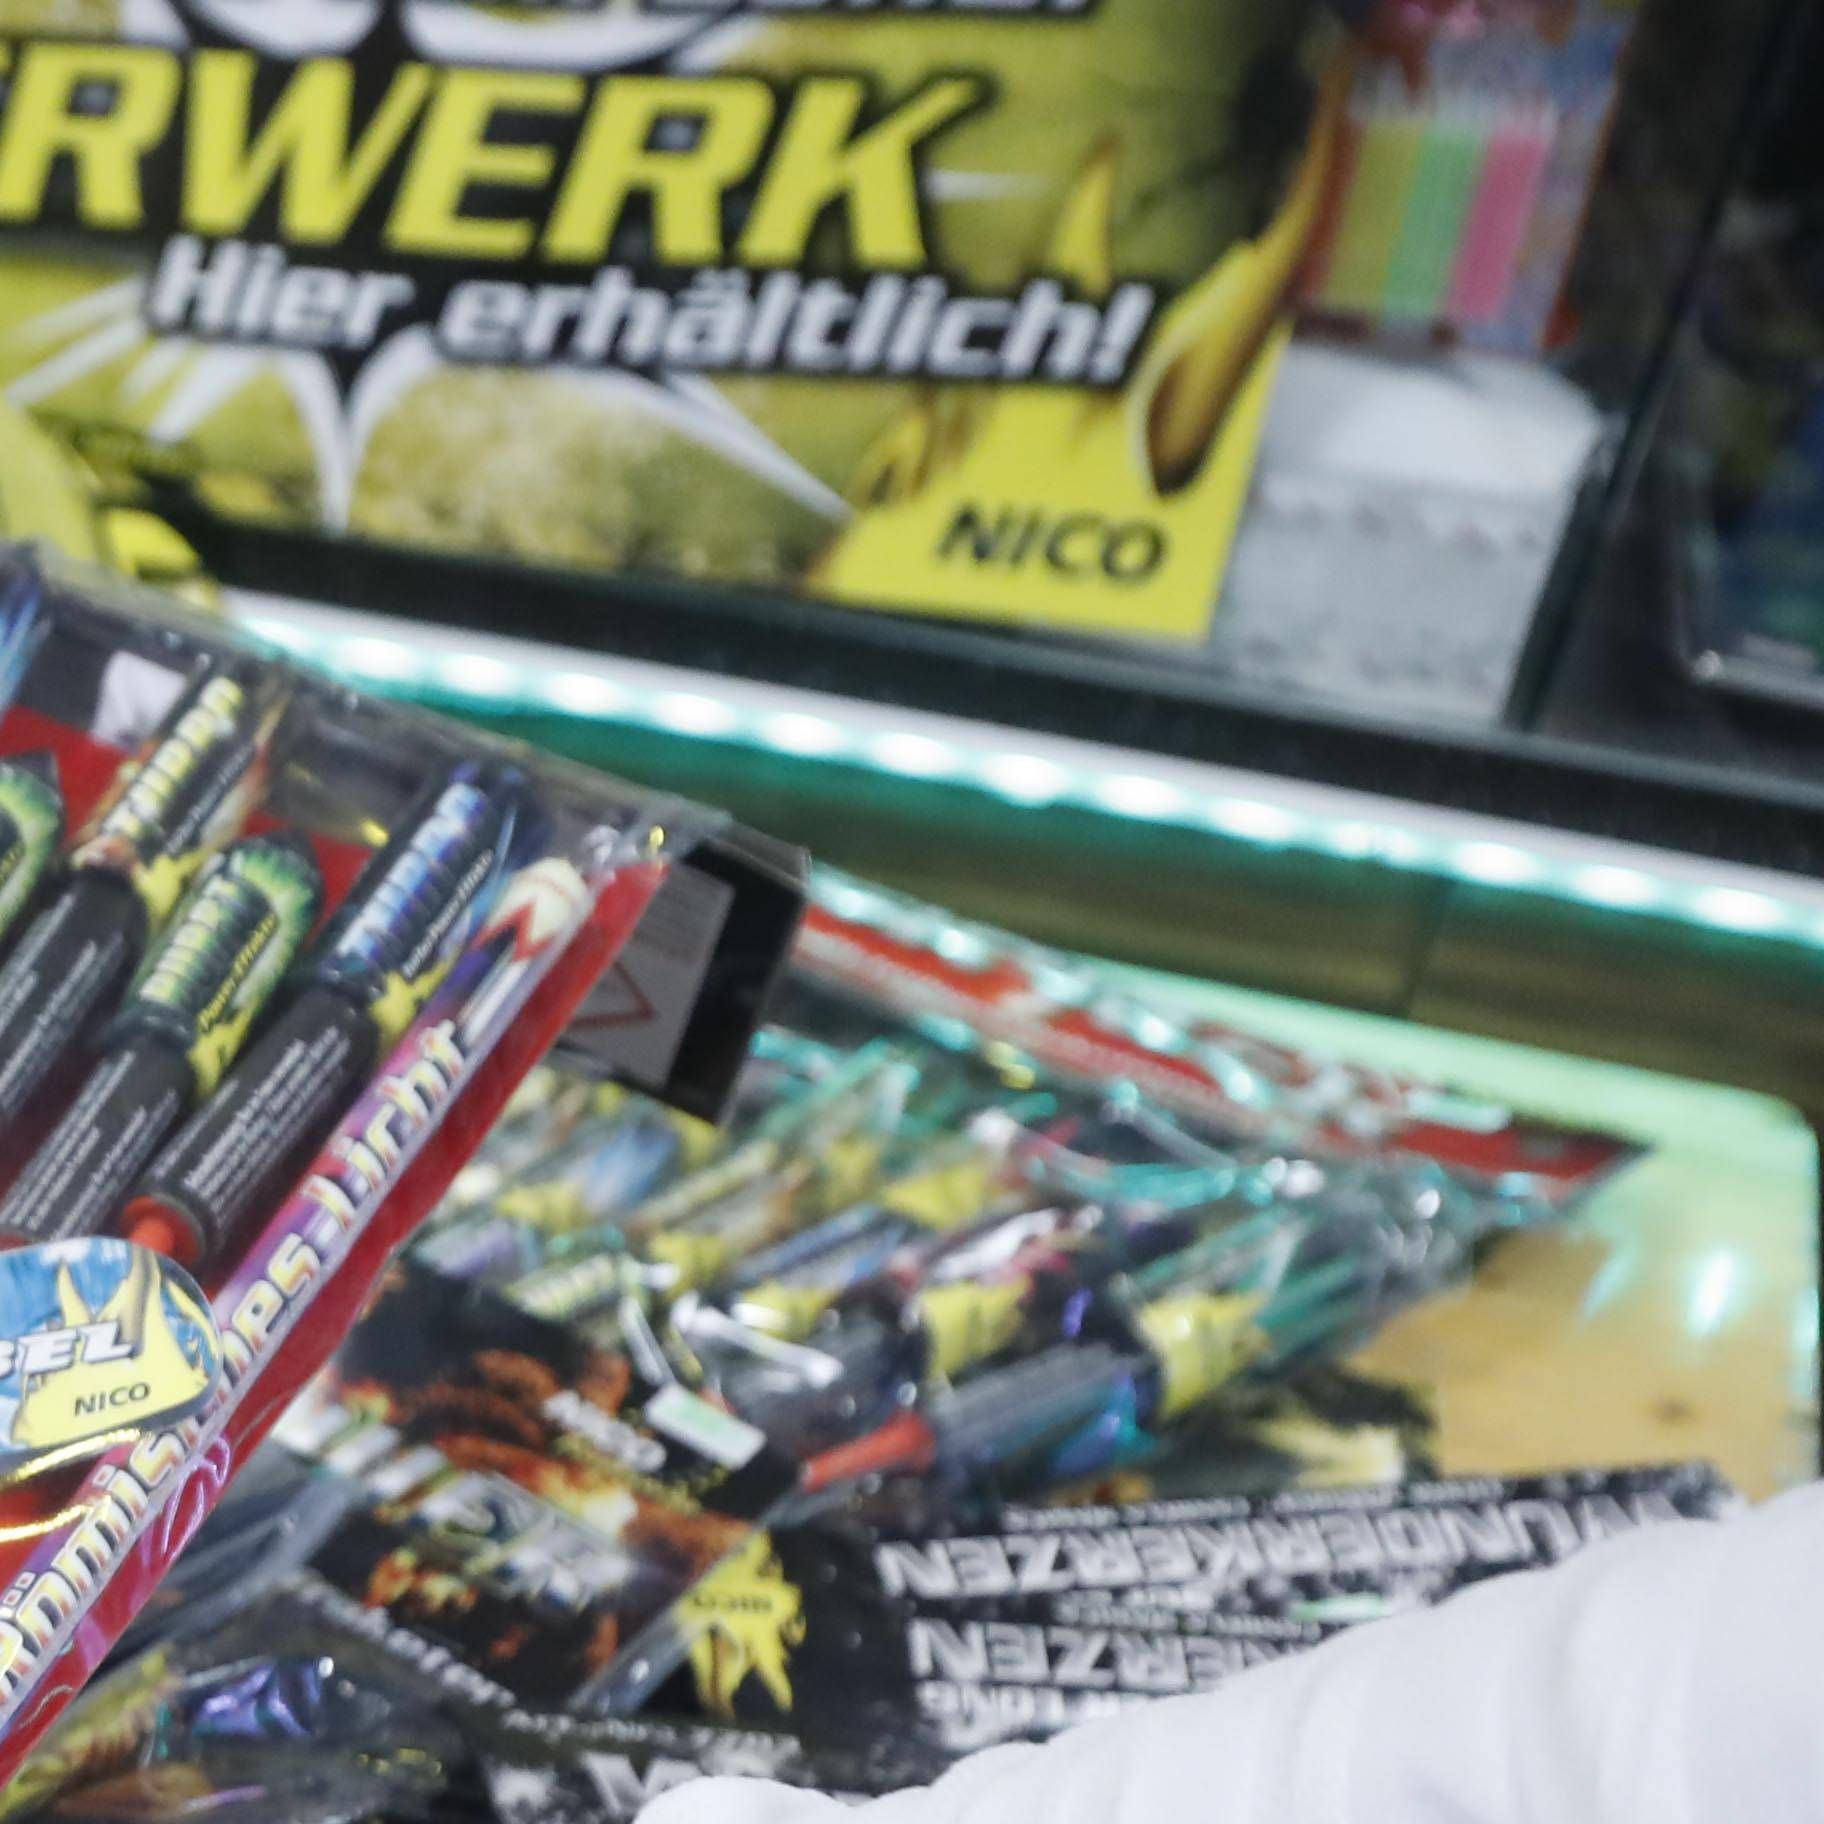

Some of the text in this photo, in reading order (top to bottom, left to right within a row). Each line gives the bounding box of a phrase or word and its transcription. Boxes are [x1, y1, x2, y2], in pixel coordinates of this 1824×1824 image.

[156, 236, 1156, 382] Hier erhältlich!
[936, 504, 1168, 586] NICO
[73, 1380, 151, 1418] NICO
